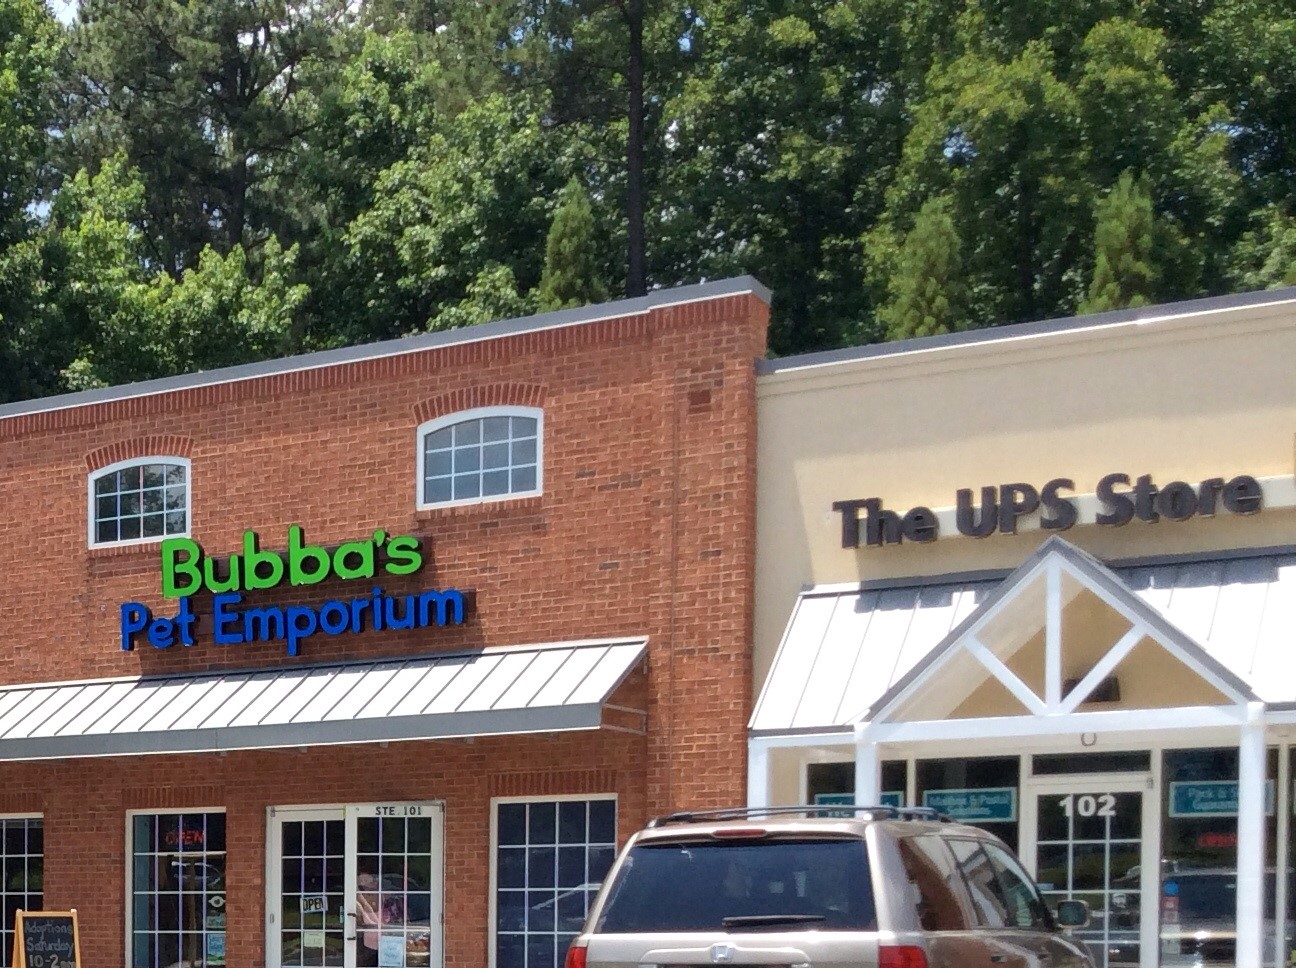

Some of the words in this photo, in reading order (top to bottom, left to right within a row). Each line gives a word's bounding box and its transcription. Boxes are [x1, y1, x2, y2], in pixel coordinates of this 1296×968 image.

[832, 497, 939, 549] The
[956, 478, 1078, 538] UPS
[1095, 473, 1262, 527] Store
[162, 524, 423, 599] Bubba's
[121, 597, 197, 651] Pet
[213, 587, 465, 657] Emporium
[404, 806, 422, 816] 101
[1058, 794, 1117, 818] 102
[165, 829, 205, 846] OPEN
[27, 936, 74, 958] Saturday
